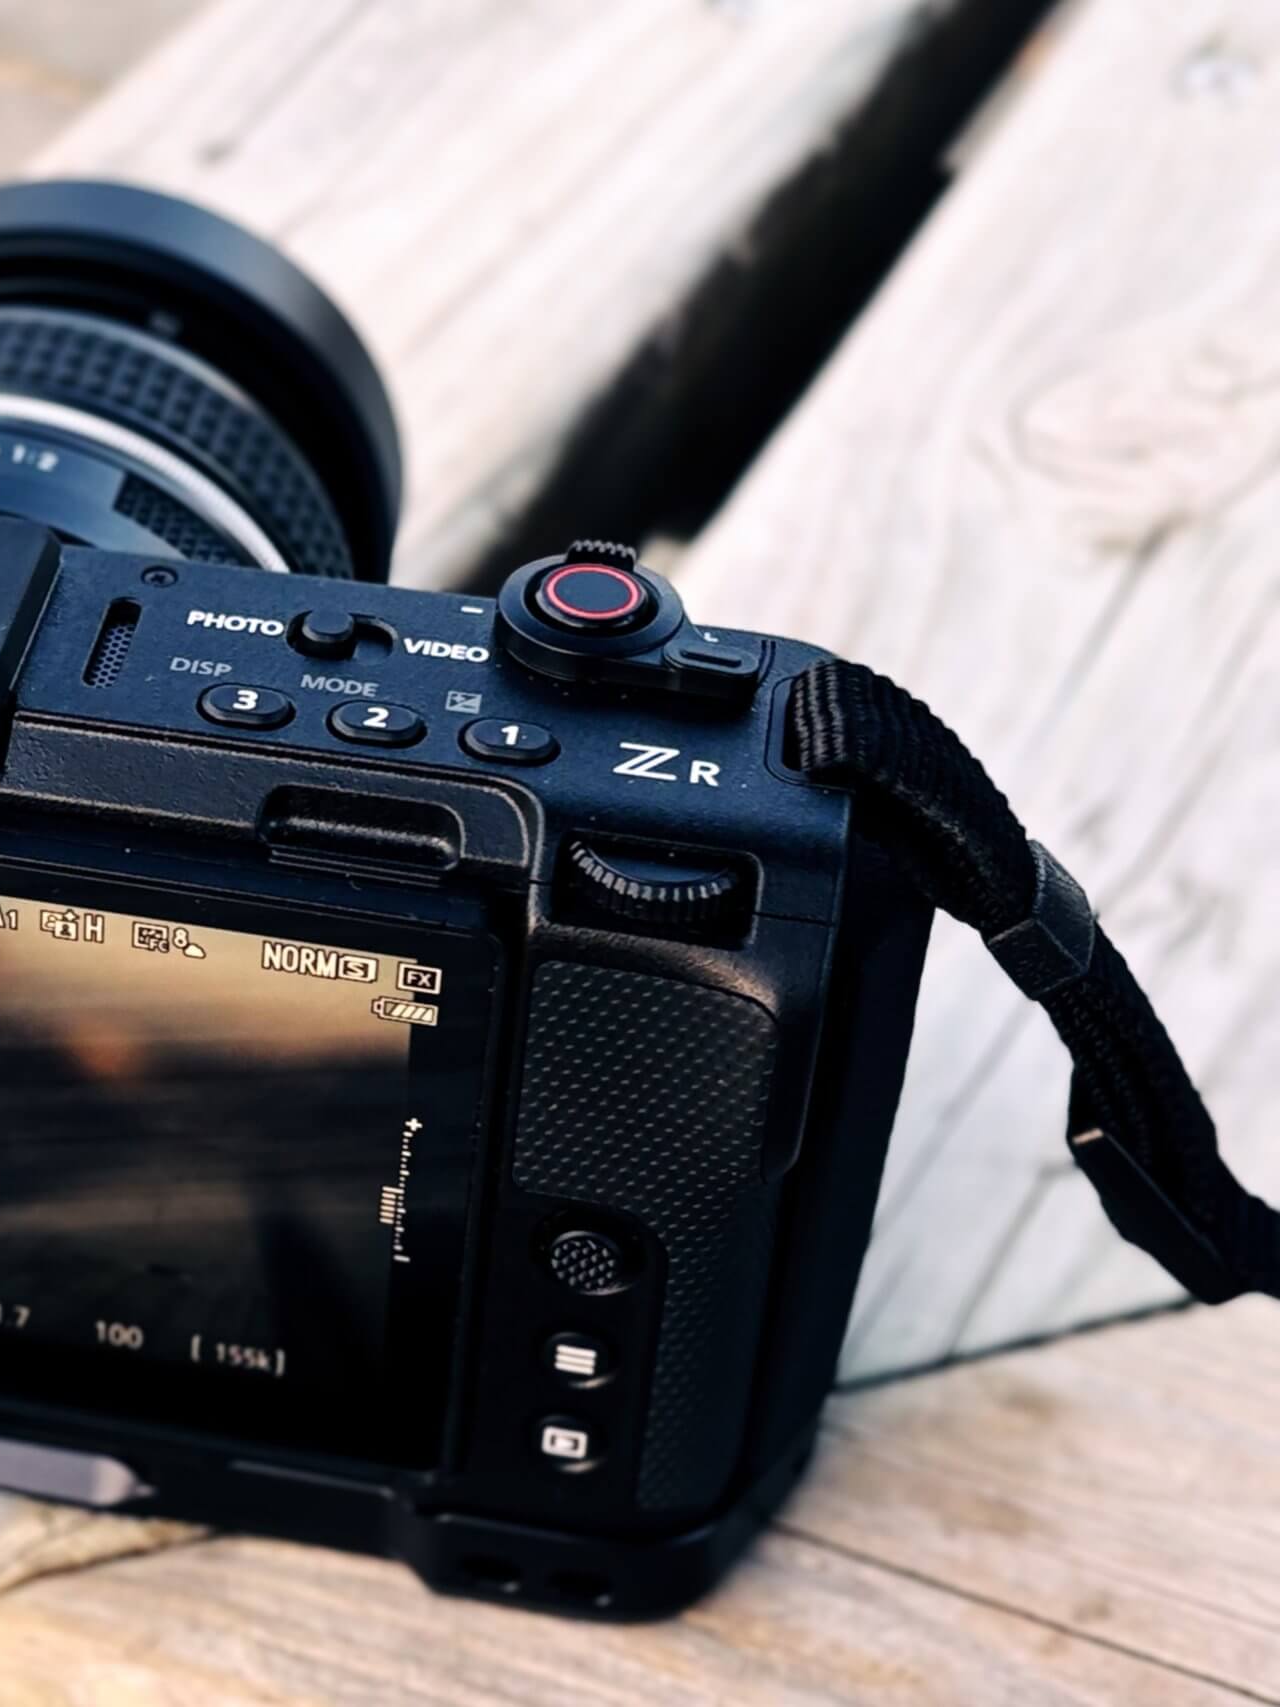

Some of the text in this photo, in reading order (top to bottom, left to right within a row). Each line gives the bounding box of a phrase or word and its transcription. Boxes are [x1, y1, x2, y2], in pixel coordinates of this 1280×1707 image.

[186, 609, 285, 637] PHOTO
[402, 637, 490, 664] VIDEO
[170, 656, 232, 677] DISP
[300, 674, 380, 698] MODE
[232, 689, 259, 711] 3
[362, 706, 390, 729] 2
[500, 724, 520, 746] 1
[84, 914, 104, 943] H
[262, 941, 339, 979] NORM
[95, 1320, 144, 1350] 100
